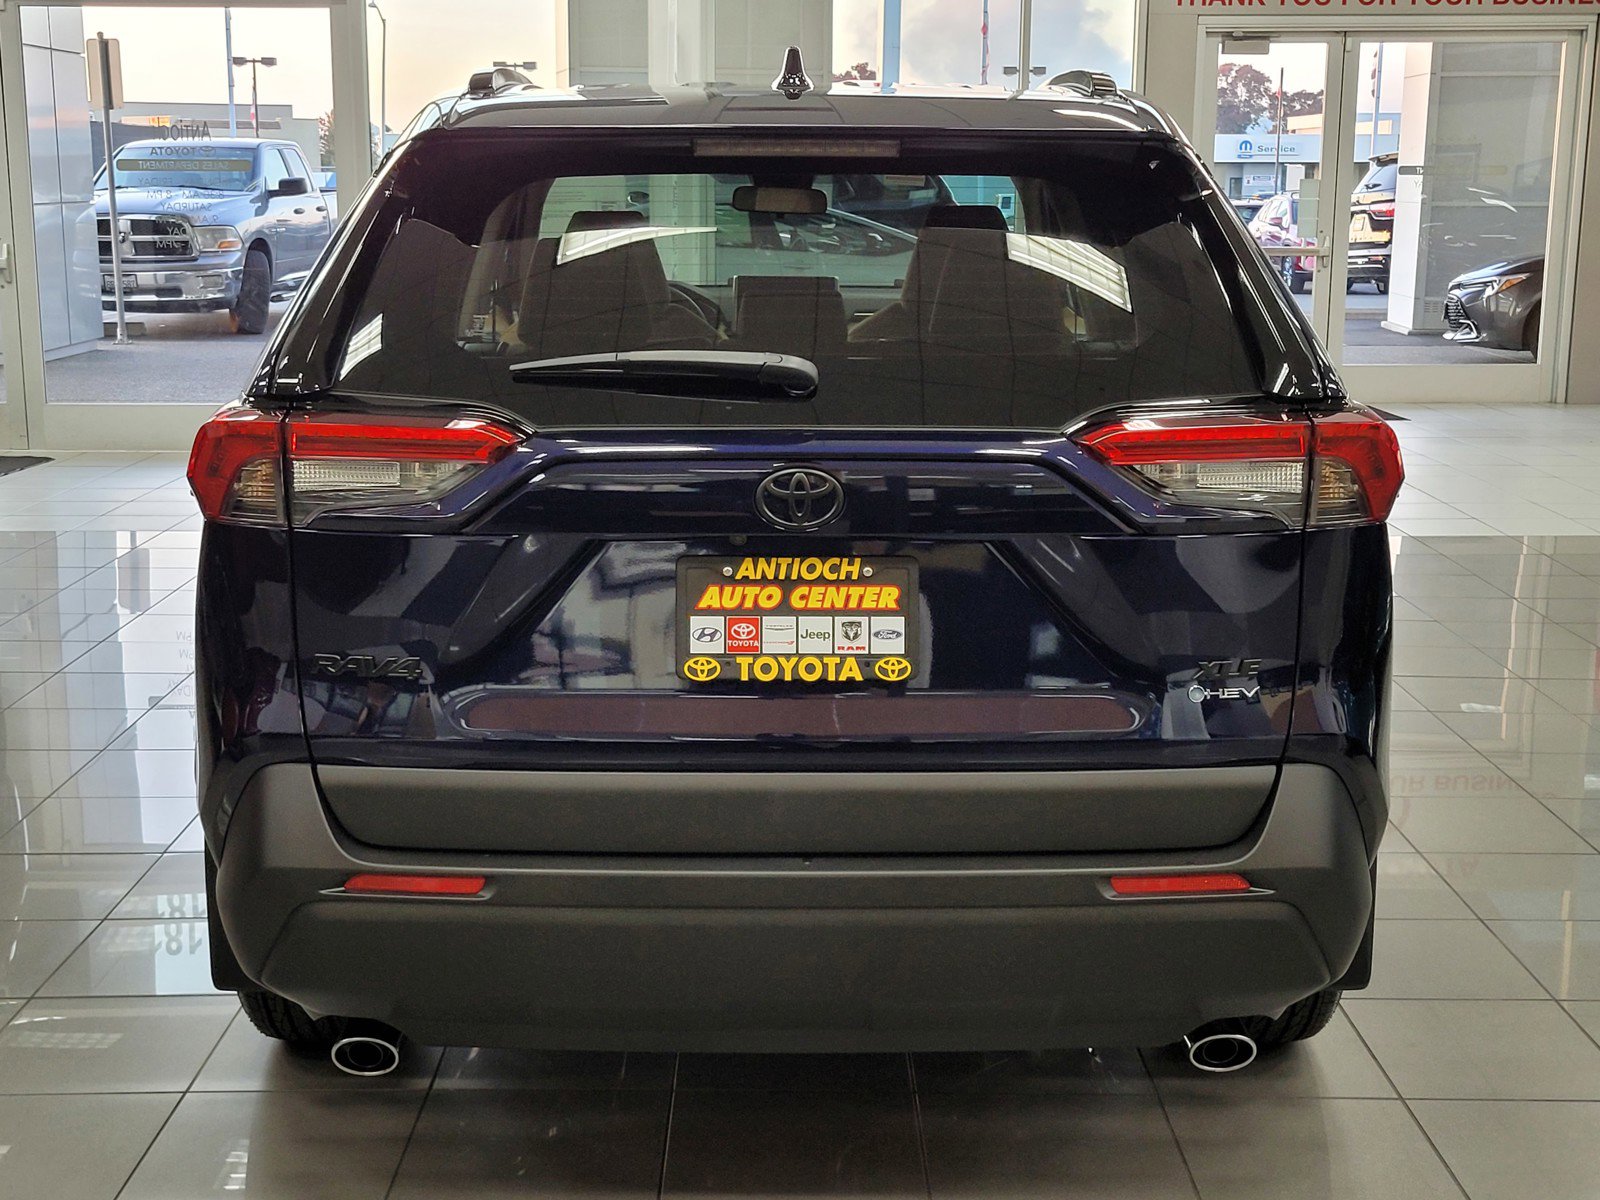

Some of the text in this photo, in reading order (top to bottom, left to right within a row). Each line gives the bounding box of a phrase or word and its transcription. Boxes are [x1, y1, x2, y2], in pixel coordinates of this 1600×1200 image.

[735, 557, 862, 580] ANTIOCH
[694, 584, 901, 610] AUTO CENTER
[800, 628, 831, 642] Jeep
[313, 652, 422, 680] RAV4
[735, 656, 863, 682] TOYOTA
[1192, 658, 1262, 680] XLE
